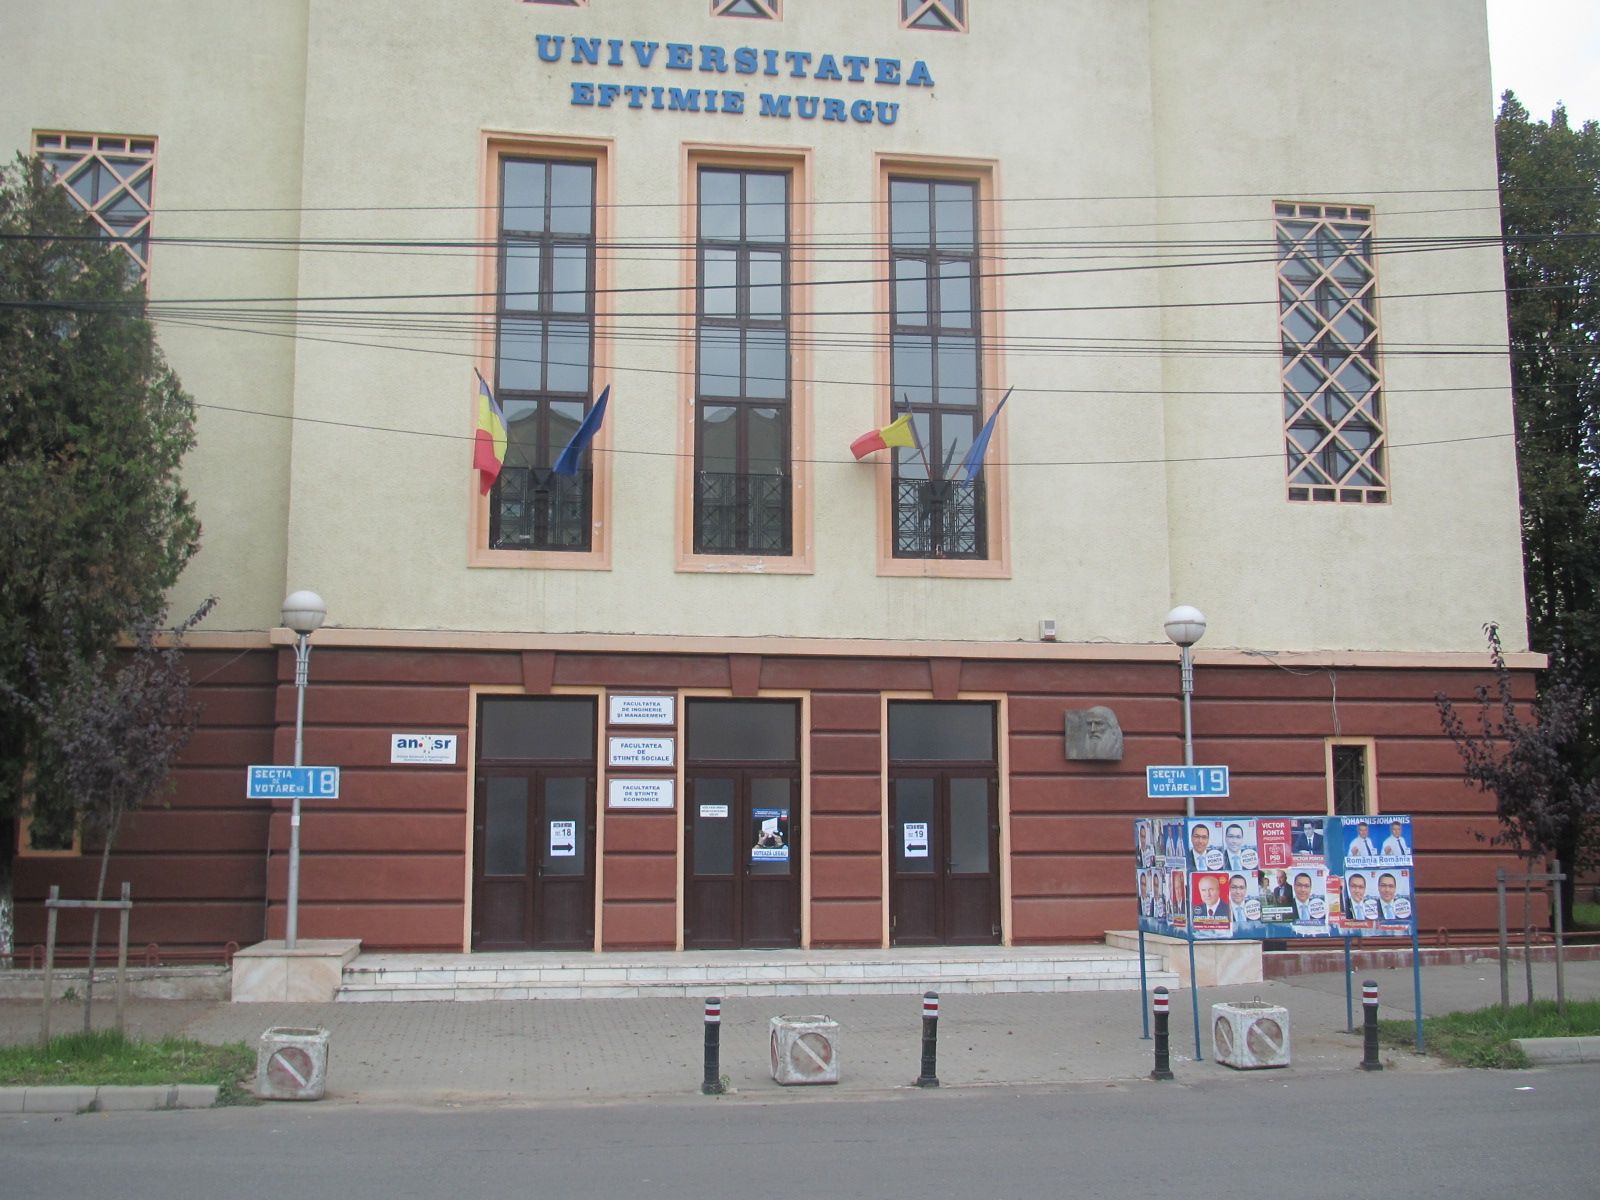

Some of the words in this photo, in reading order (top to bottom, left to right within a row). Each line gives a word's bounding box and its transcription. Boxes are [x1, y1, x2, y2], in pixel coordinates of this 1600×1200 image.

[534, 34, 935, 87] UNIVERSITATEA
[570, 82, 745, 114] EFTIMIE
[759, 93, 900, 125] MURGU
[255, 769, 293, 779] SECTIA
[1152, 770, 1186, 779] SECTIA
[255, 784, 296, 793] VOTARE
[307, 769, 335, 794] 18
[1153, 783, 1189, 792] VOTARE
[1198, 769, 1224, 792] 19
[562, 828, 572, 837] 18
[915, 830, 924, 838] 19
[1346, 856, 1377, 864] România
